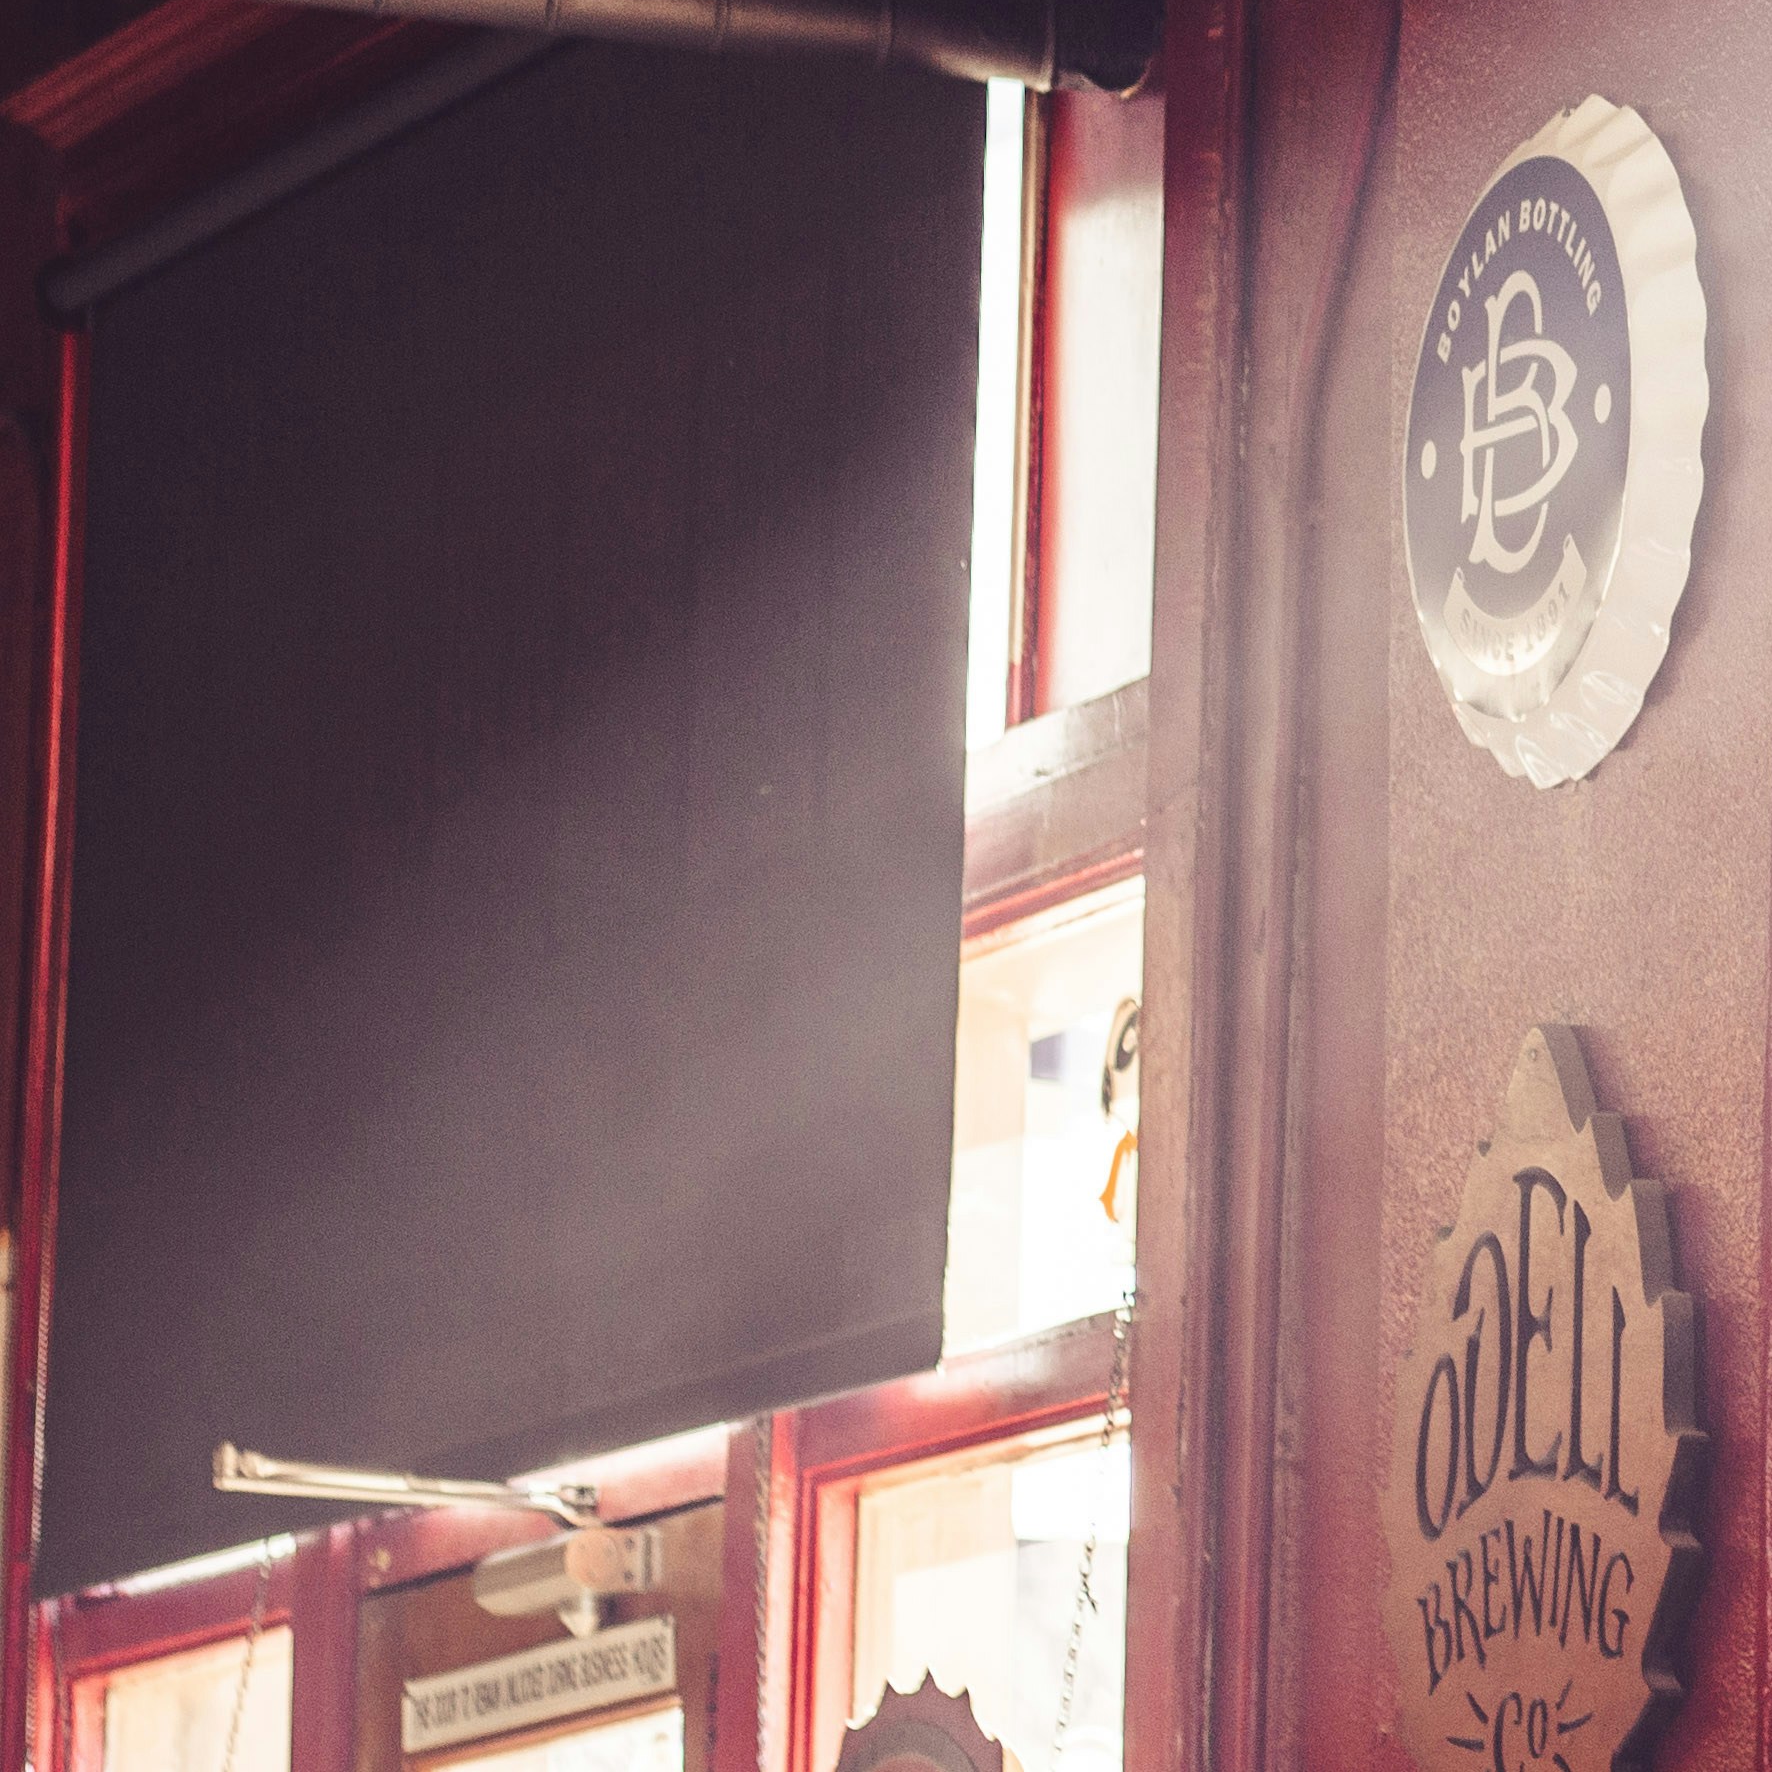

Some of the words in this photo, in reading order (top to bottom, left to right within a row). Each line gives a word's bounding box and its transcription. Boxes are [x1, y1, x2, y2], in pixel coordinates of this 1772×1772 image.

[1437, 210, 1510, 365] BOYLAN
[1518, 197, 1602, 317] BOTTLING
[1415, 1166, 1640, 1541] ODELL
[1416, 1509, 1635, 1696] BREWING
